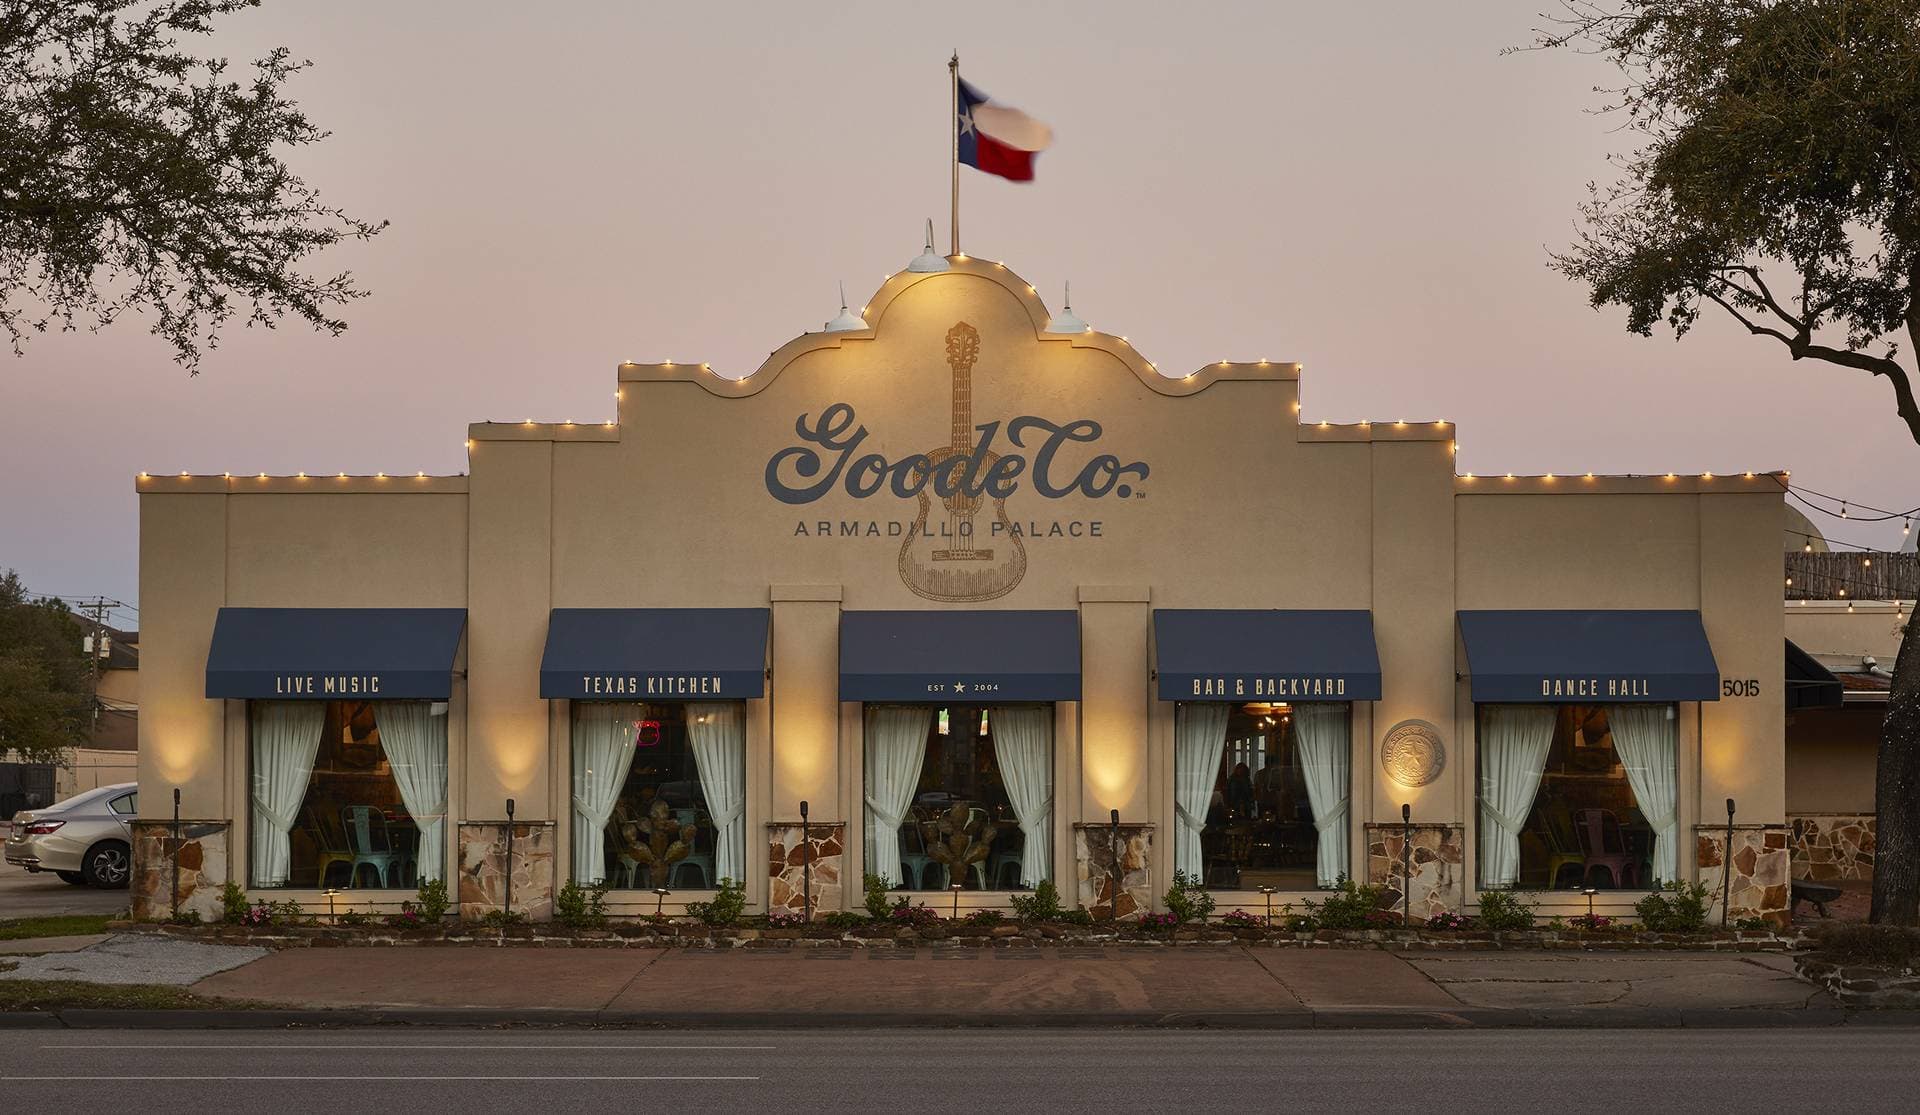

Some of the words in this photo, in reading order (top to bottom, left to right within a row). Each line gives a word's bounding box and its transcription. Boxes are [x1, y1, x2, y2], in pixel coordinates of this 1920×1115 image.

[765, 403, 1026, 504] Goode
[794, 521, 973, 537] ARMADILLO
[991, 521, 1103, 537] PALACE
[276, 677, 314, 694] LIVE
[324, 677, 380, 694] MUSIC
[583, 677, 637, 694] TEXAS
[647, 677, 722, 694] KITCHEN
[927, 684, 945, 692] EST
[1193, 679, 1225, 695] BAR
[1236, 679, 1244, 695] &
[1255, 679, 1346, 695] BACKYARD
[1542, 680, 1598, 695] DANCE
[1608, 680, 1650, 695] HALL
[1722, 679, 1760, 697] 5015
